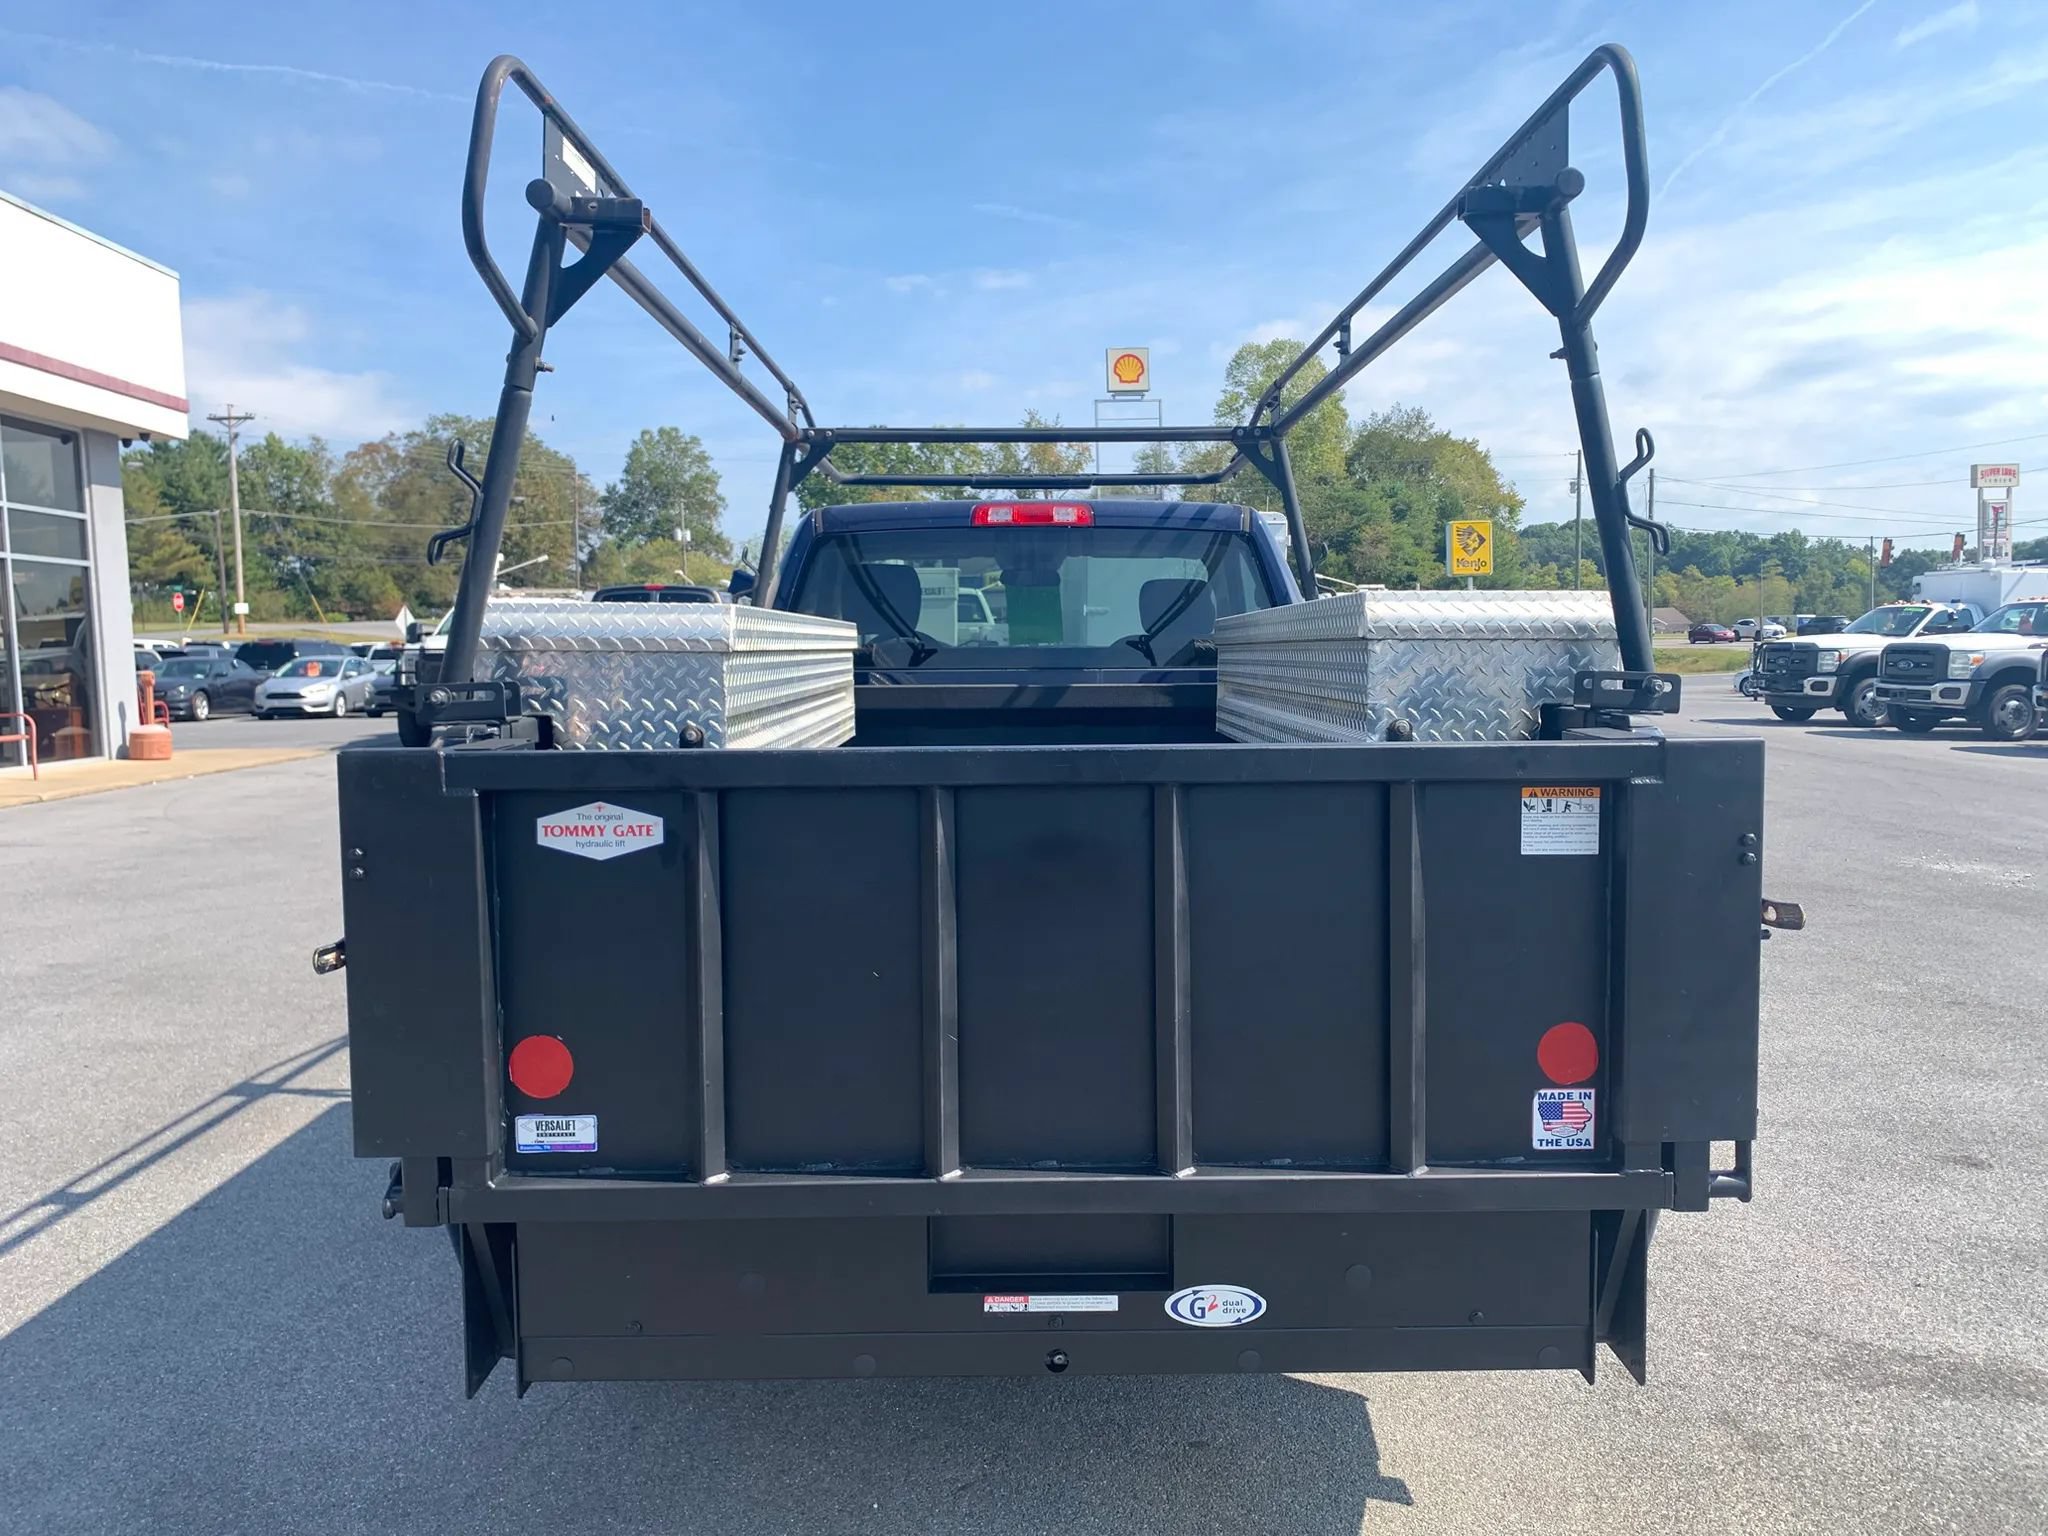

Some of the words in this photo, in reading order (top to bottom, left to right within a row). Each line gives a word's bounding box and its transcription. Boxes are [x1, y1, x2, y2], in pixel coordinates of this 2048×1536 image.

[1541, 788, 1594, 797] WARNING
[594, 813, 624, 822] original
[542, 825, 606, 837] TOMMY
[613, 825, 654, 837] GATE
[575, 840, 613, 848] hydraulic
[1537, 1092, 1574, 1101] MADE
[1579, 1092, 1592, 1100] IN
[535, 1120, 576, 1131] VERSALIFT
[1537, 1139, 1562, 1147] THE
[1566, 1138, 1592, 1147] USA
